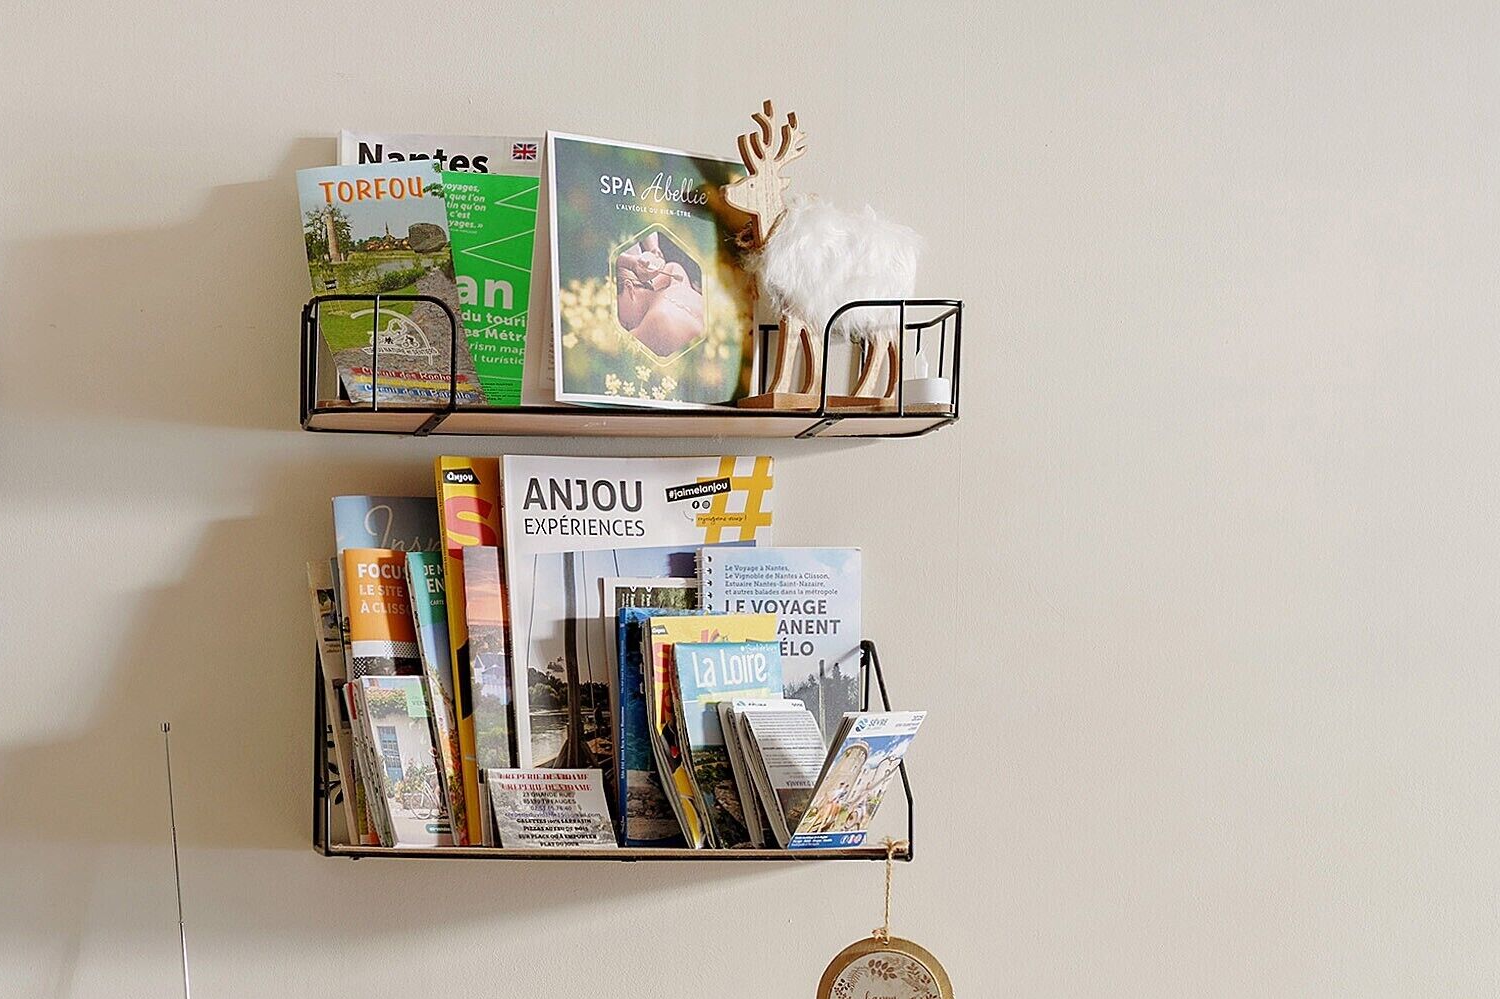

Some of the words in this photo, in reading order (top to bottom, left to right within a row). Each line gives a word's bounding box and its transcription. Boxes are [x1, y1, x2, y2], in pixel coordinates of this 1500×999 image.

[318, 175, 425, 206] TORFOU
[600, 175, 635, 196] SPA
[641, 172, 708, 205] Abellie
[467, 193, 485, 203] l'on
[460, 201, 486, 212] qu'on
[450, 211, 470, 219] c'est
[523, 477, 643, 513] ANJOU
[668, 481, 729, 500] #jaimelanjou
[524, 514, 646, 537] EXPÉRIENCES
[423, 565, 435, 576] JE
[734, 565, 759, 573] Voyage
[734, 573, 762, 581] Vignoble
[804, 572, 830, 580] Clisson,
[359, 584, 375, 595] LE
[378, 585, 403, 597] SITE
[751, 599, 827, 615] VOYAGE
[692, 652, 717, 688] La
[719, 649, 767, 686] Loire
